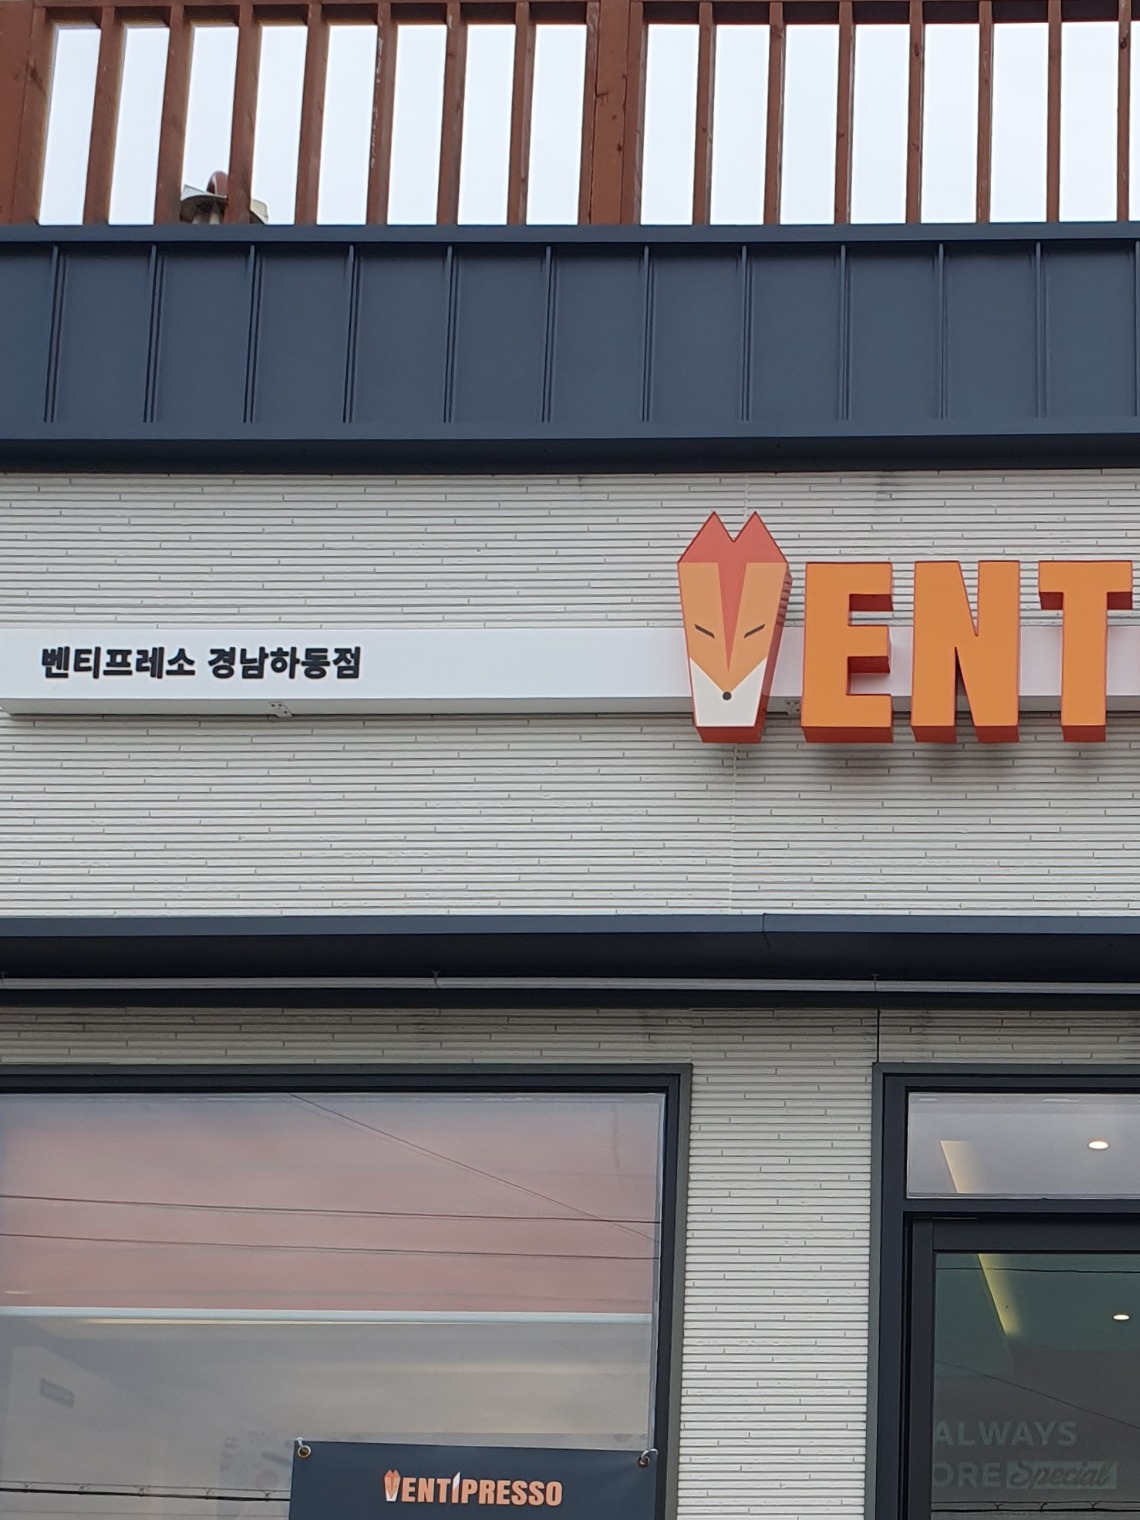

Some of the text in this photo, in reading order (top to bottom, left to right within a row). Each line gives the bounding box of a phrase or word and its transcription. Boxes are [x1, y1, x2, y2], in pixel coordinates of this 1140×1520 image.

[41, 646, 362, 681] 벤티프레소 경남하동점
[934, 1421, 1078, 1447] ALWAYS
[1009, 1457, 1113, 1490] Special
